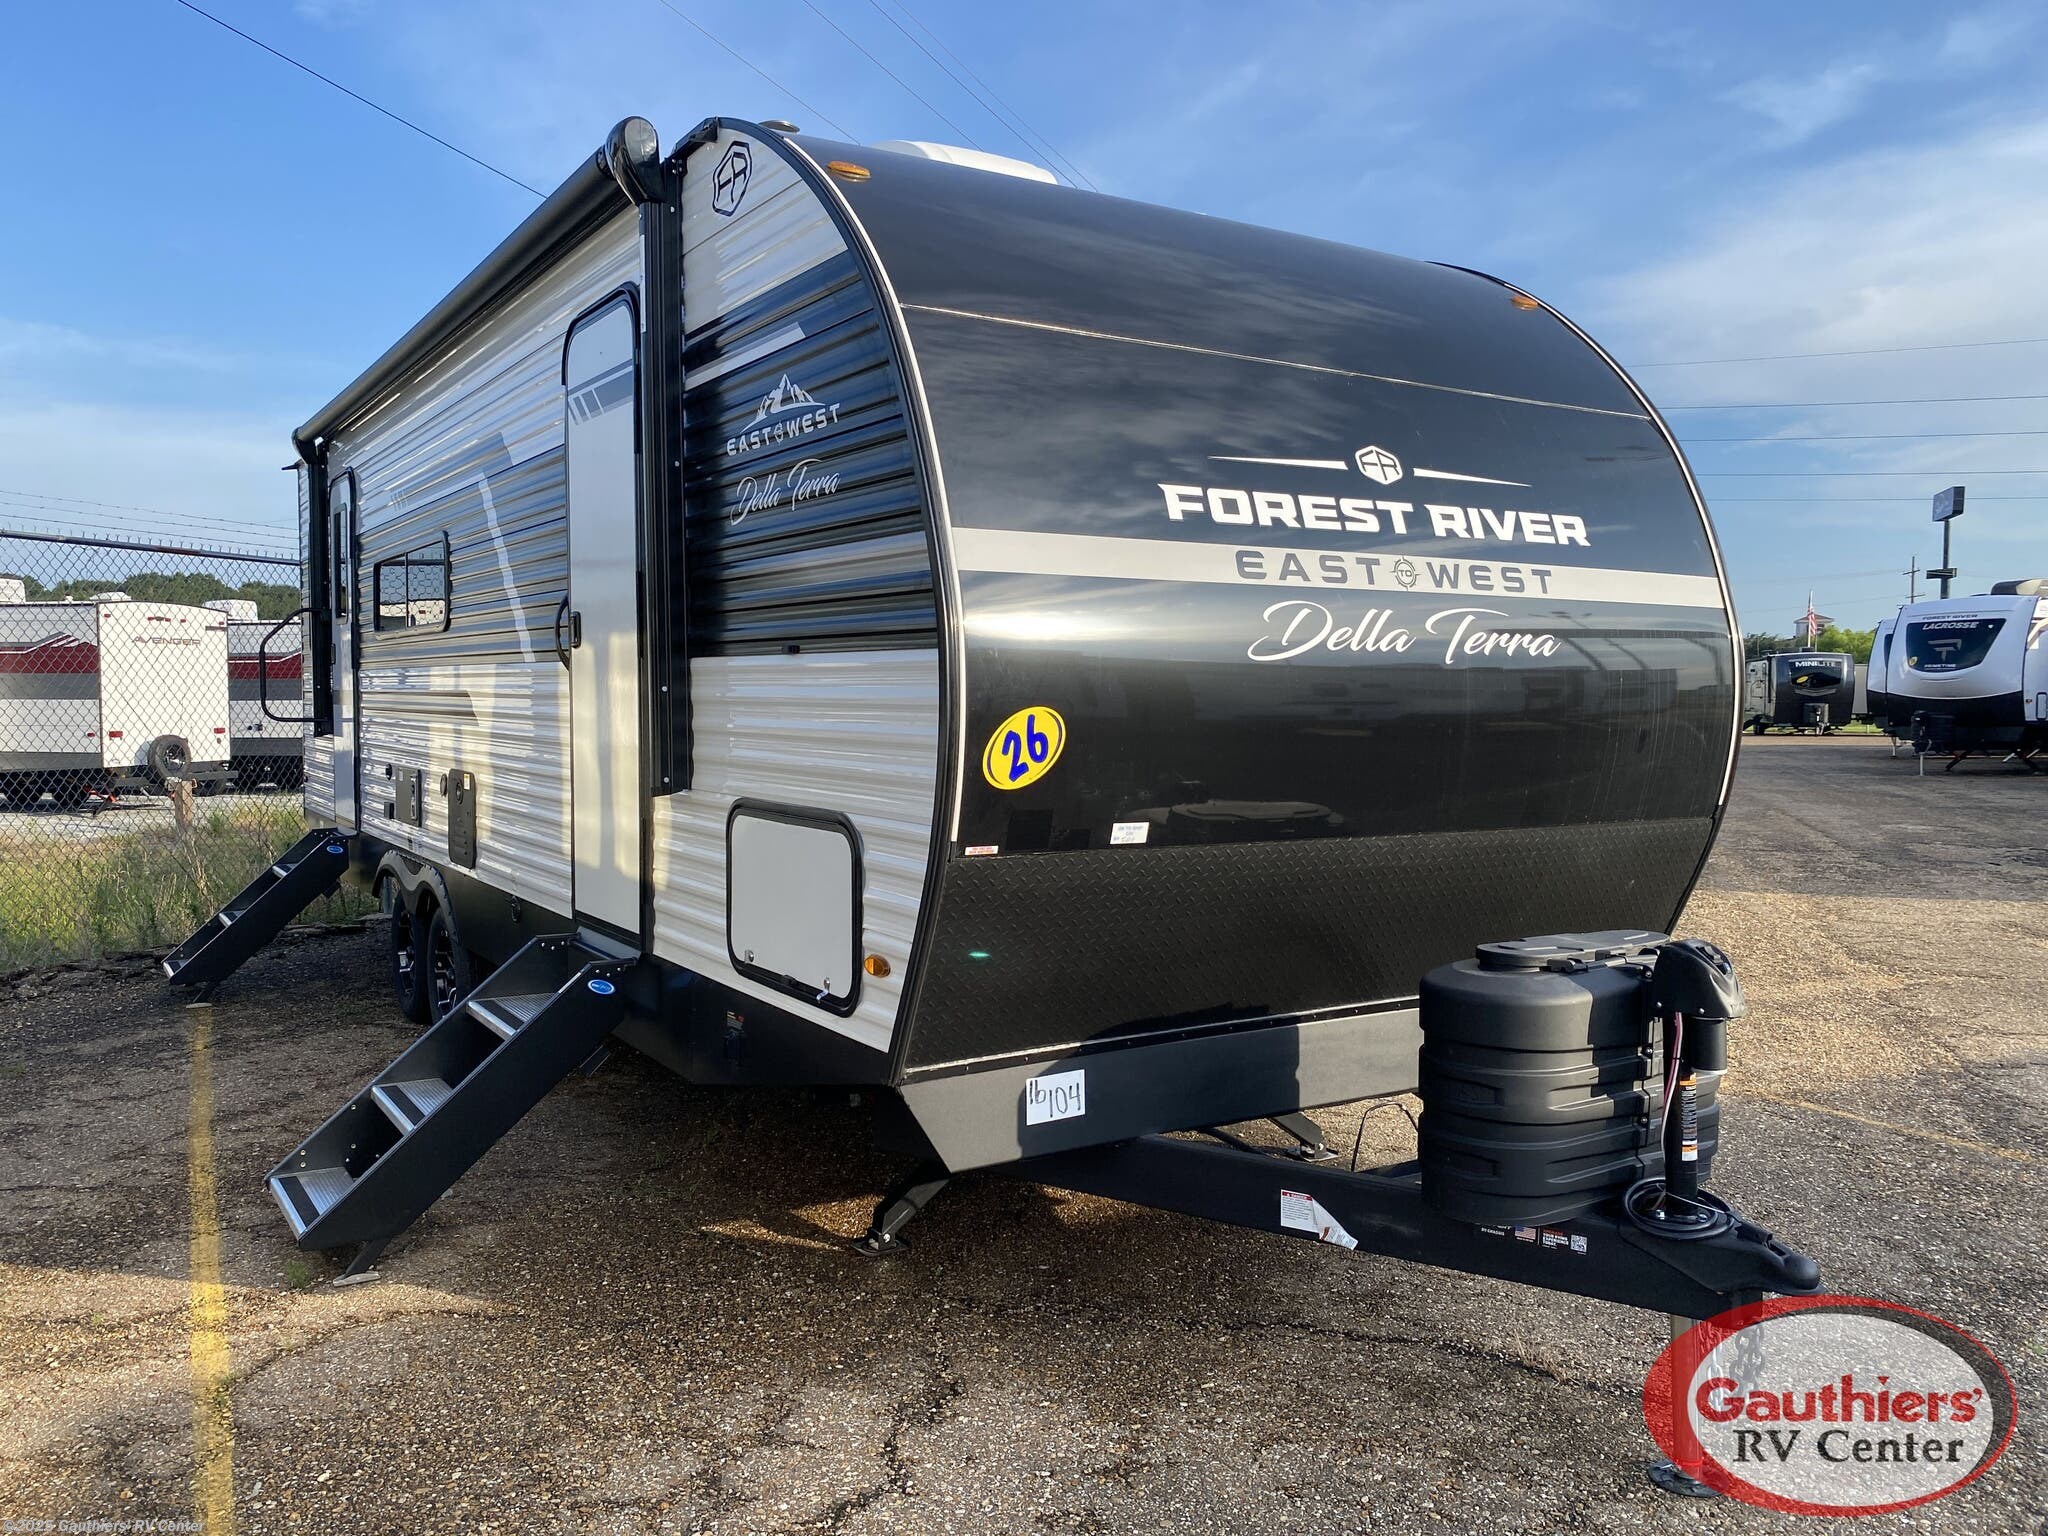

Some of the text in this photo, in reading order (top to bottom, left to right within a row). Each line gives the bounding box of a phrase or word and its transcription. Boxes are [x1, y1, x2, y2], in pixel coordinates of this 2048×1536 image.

[726, 427, 772, 456] EAST
[786, 403, 840, 438] WEST
[730, 458, 841, 525] Della Terra
[1157, 483, 1591, 547] FOREST RIVER
[1235, 550, 1381, 586] EAST
[1425, 561, 1552, 594] WEST
[132, 635, 201, 646] AVENGER
[1247, 600, 1563, 665] Della Terra
[1922, 621, 1980, 631] LACROSSE
[1001, 713, 1049, 782] 26
